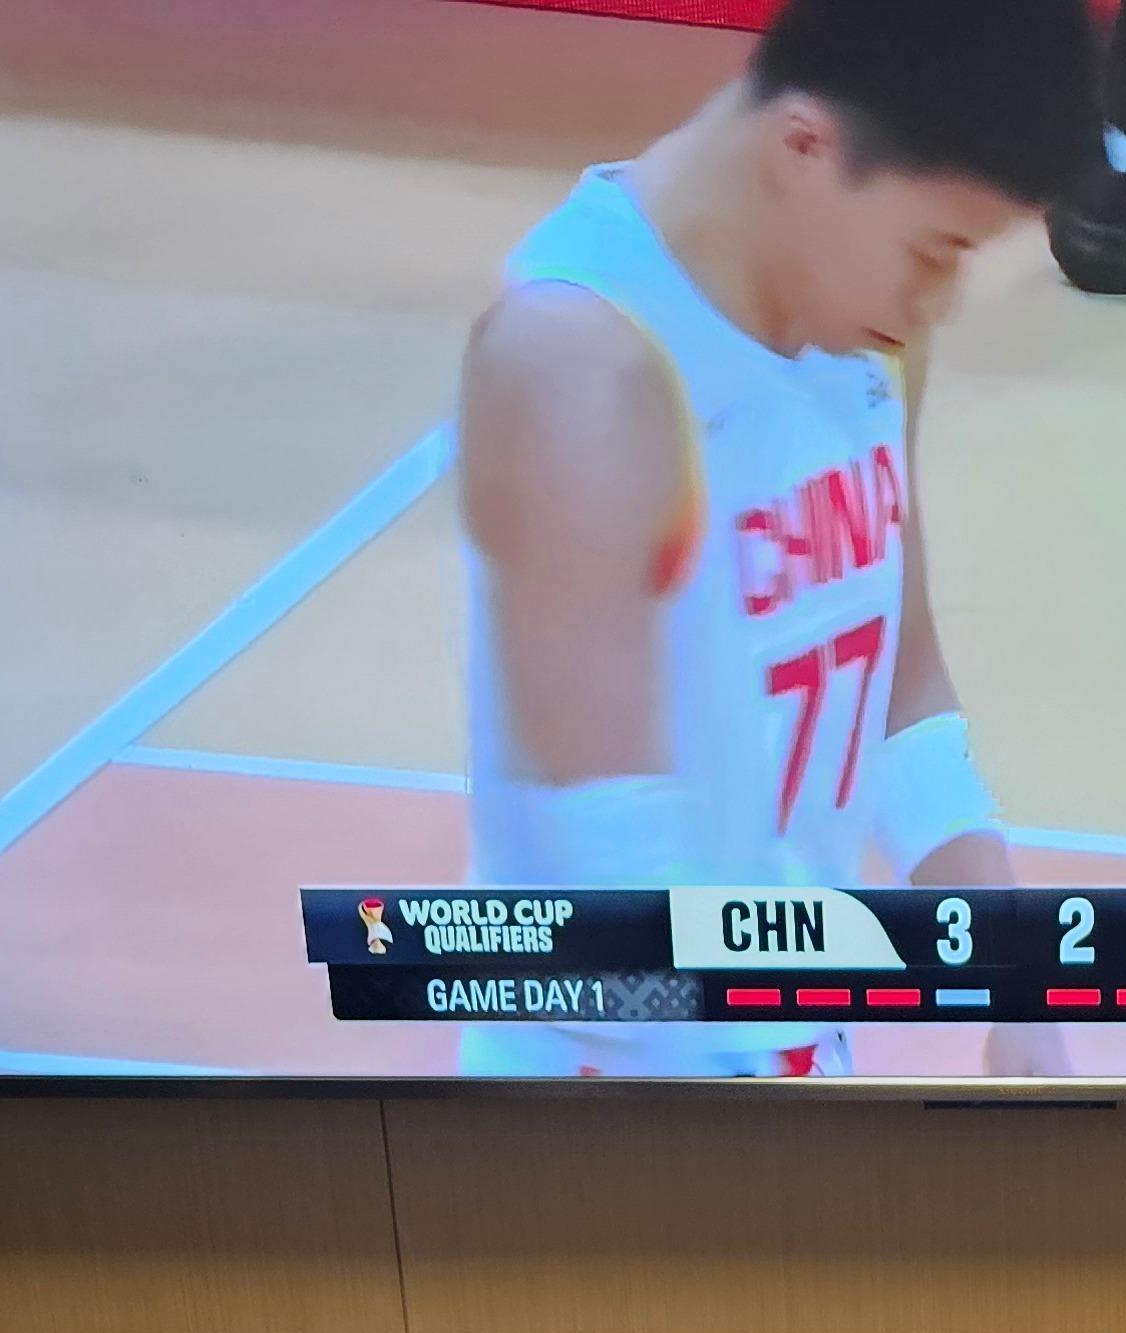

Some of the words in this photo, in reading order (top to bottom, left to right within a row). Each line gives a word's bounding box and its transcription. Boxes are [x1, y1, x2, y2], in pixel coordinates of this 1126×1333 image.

[766, 616, 886, 838] 77
[398, 899, 508, 927] WORLD
[513, 899, 574, 927] CUP
[721, 900, 826, 952] CHN
[936, 897, 973, 966] 3
[1058, 897, 1096, 965] 2
[424, 925, 554, 955] QUALIFIERS
[426, 978, 518, 1013] GAME
[523, 978, 584, 1013] DAY
[590, 979, 606, 1013] 1
